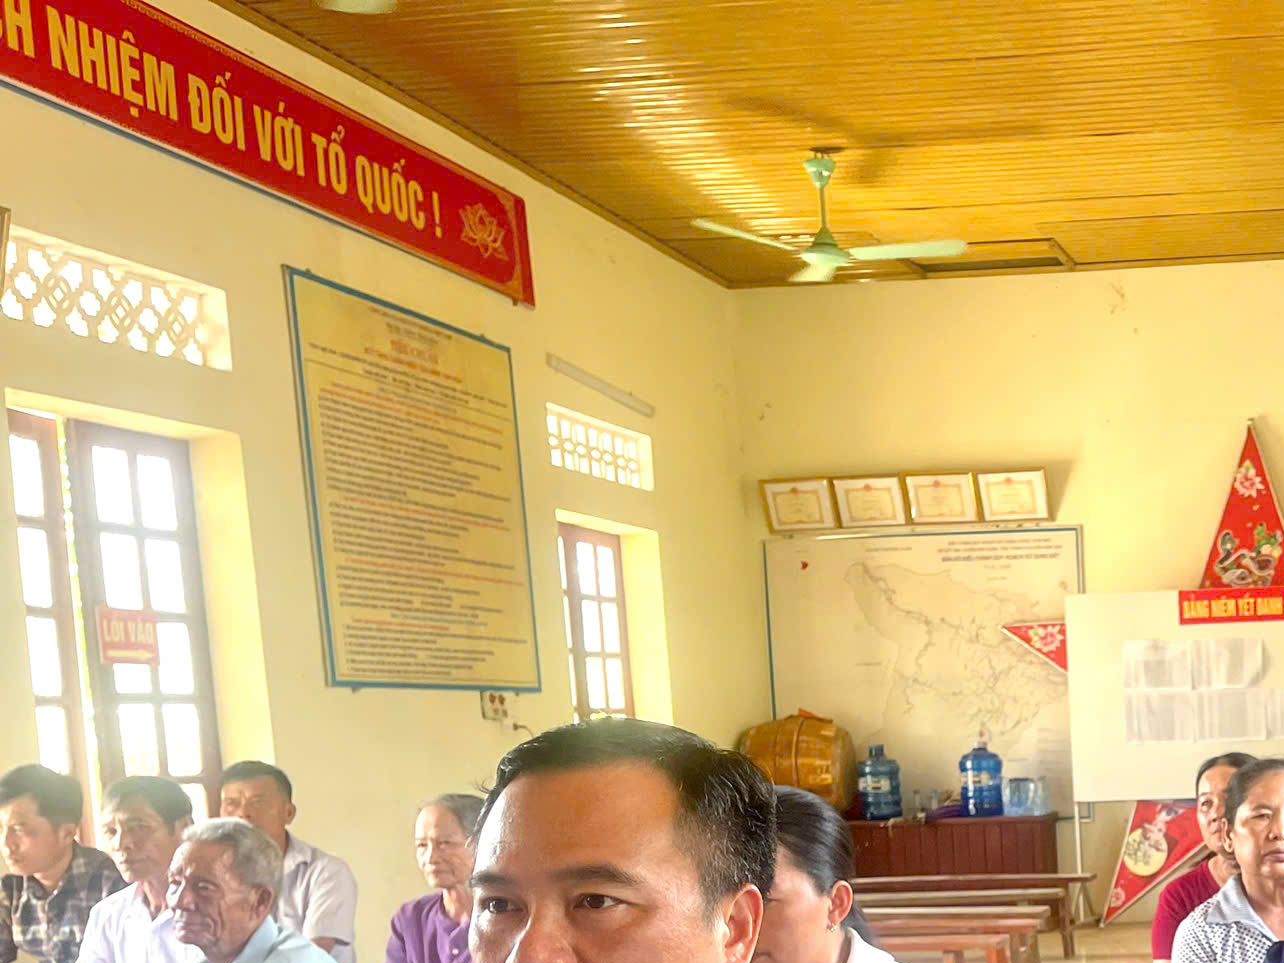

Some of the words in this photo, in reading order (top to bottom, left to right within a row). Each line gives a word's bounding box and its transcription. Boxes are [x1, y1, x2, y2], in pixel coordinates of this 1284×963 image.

[46, 5, 178, 121] NHIỆM
[187, 72, 246, 152] ĐỐI
[253, 101, 305, 177] VỚI
[311, 125, 348, 195] TỔ
[355, 159, 426, 231] QUỐC
[432, 191, 443, 239] !
